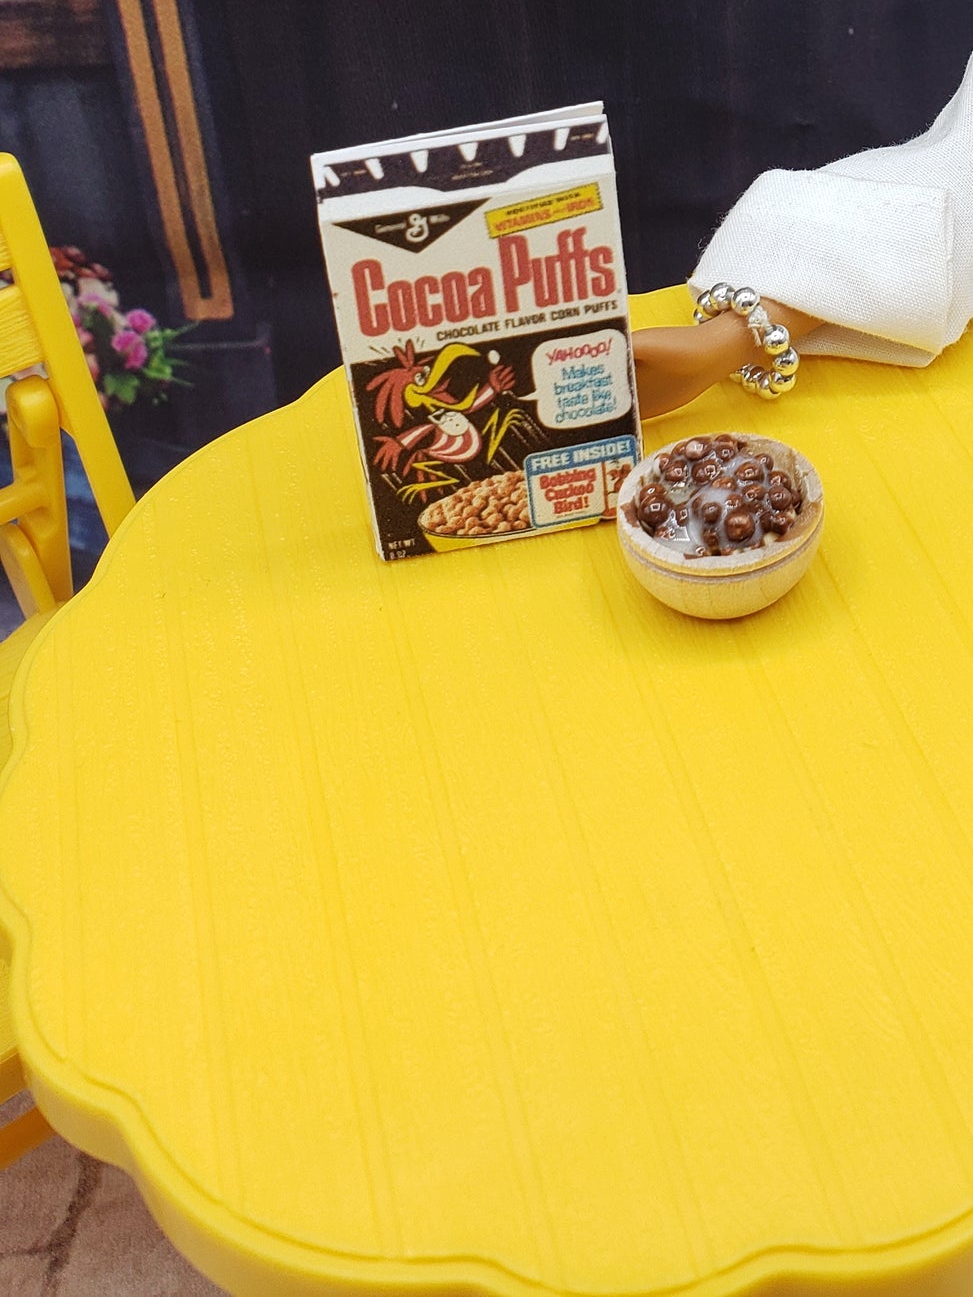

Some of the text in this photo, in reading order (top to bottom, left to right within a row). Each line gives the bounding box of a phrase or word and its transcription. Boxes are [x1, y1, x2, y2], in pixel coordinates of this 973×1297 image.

[350, 226, 615, 338] Cocoa Puffs
[436, 299, 619, 342] CHOCOLATE FLAVOR CORN PUFFS
[562, 364, 605, 381] Makes
[531, 440, 631, 471] FREE INSIDE!
[554, 496, 590, 515] Bird!
